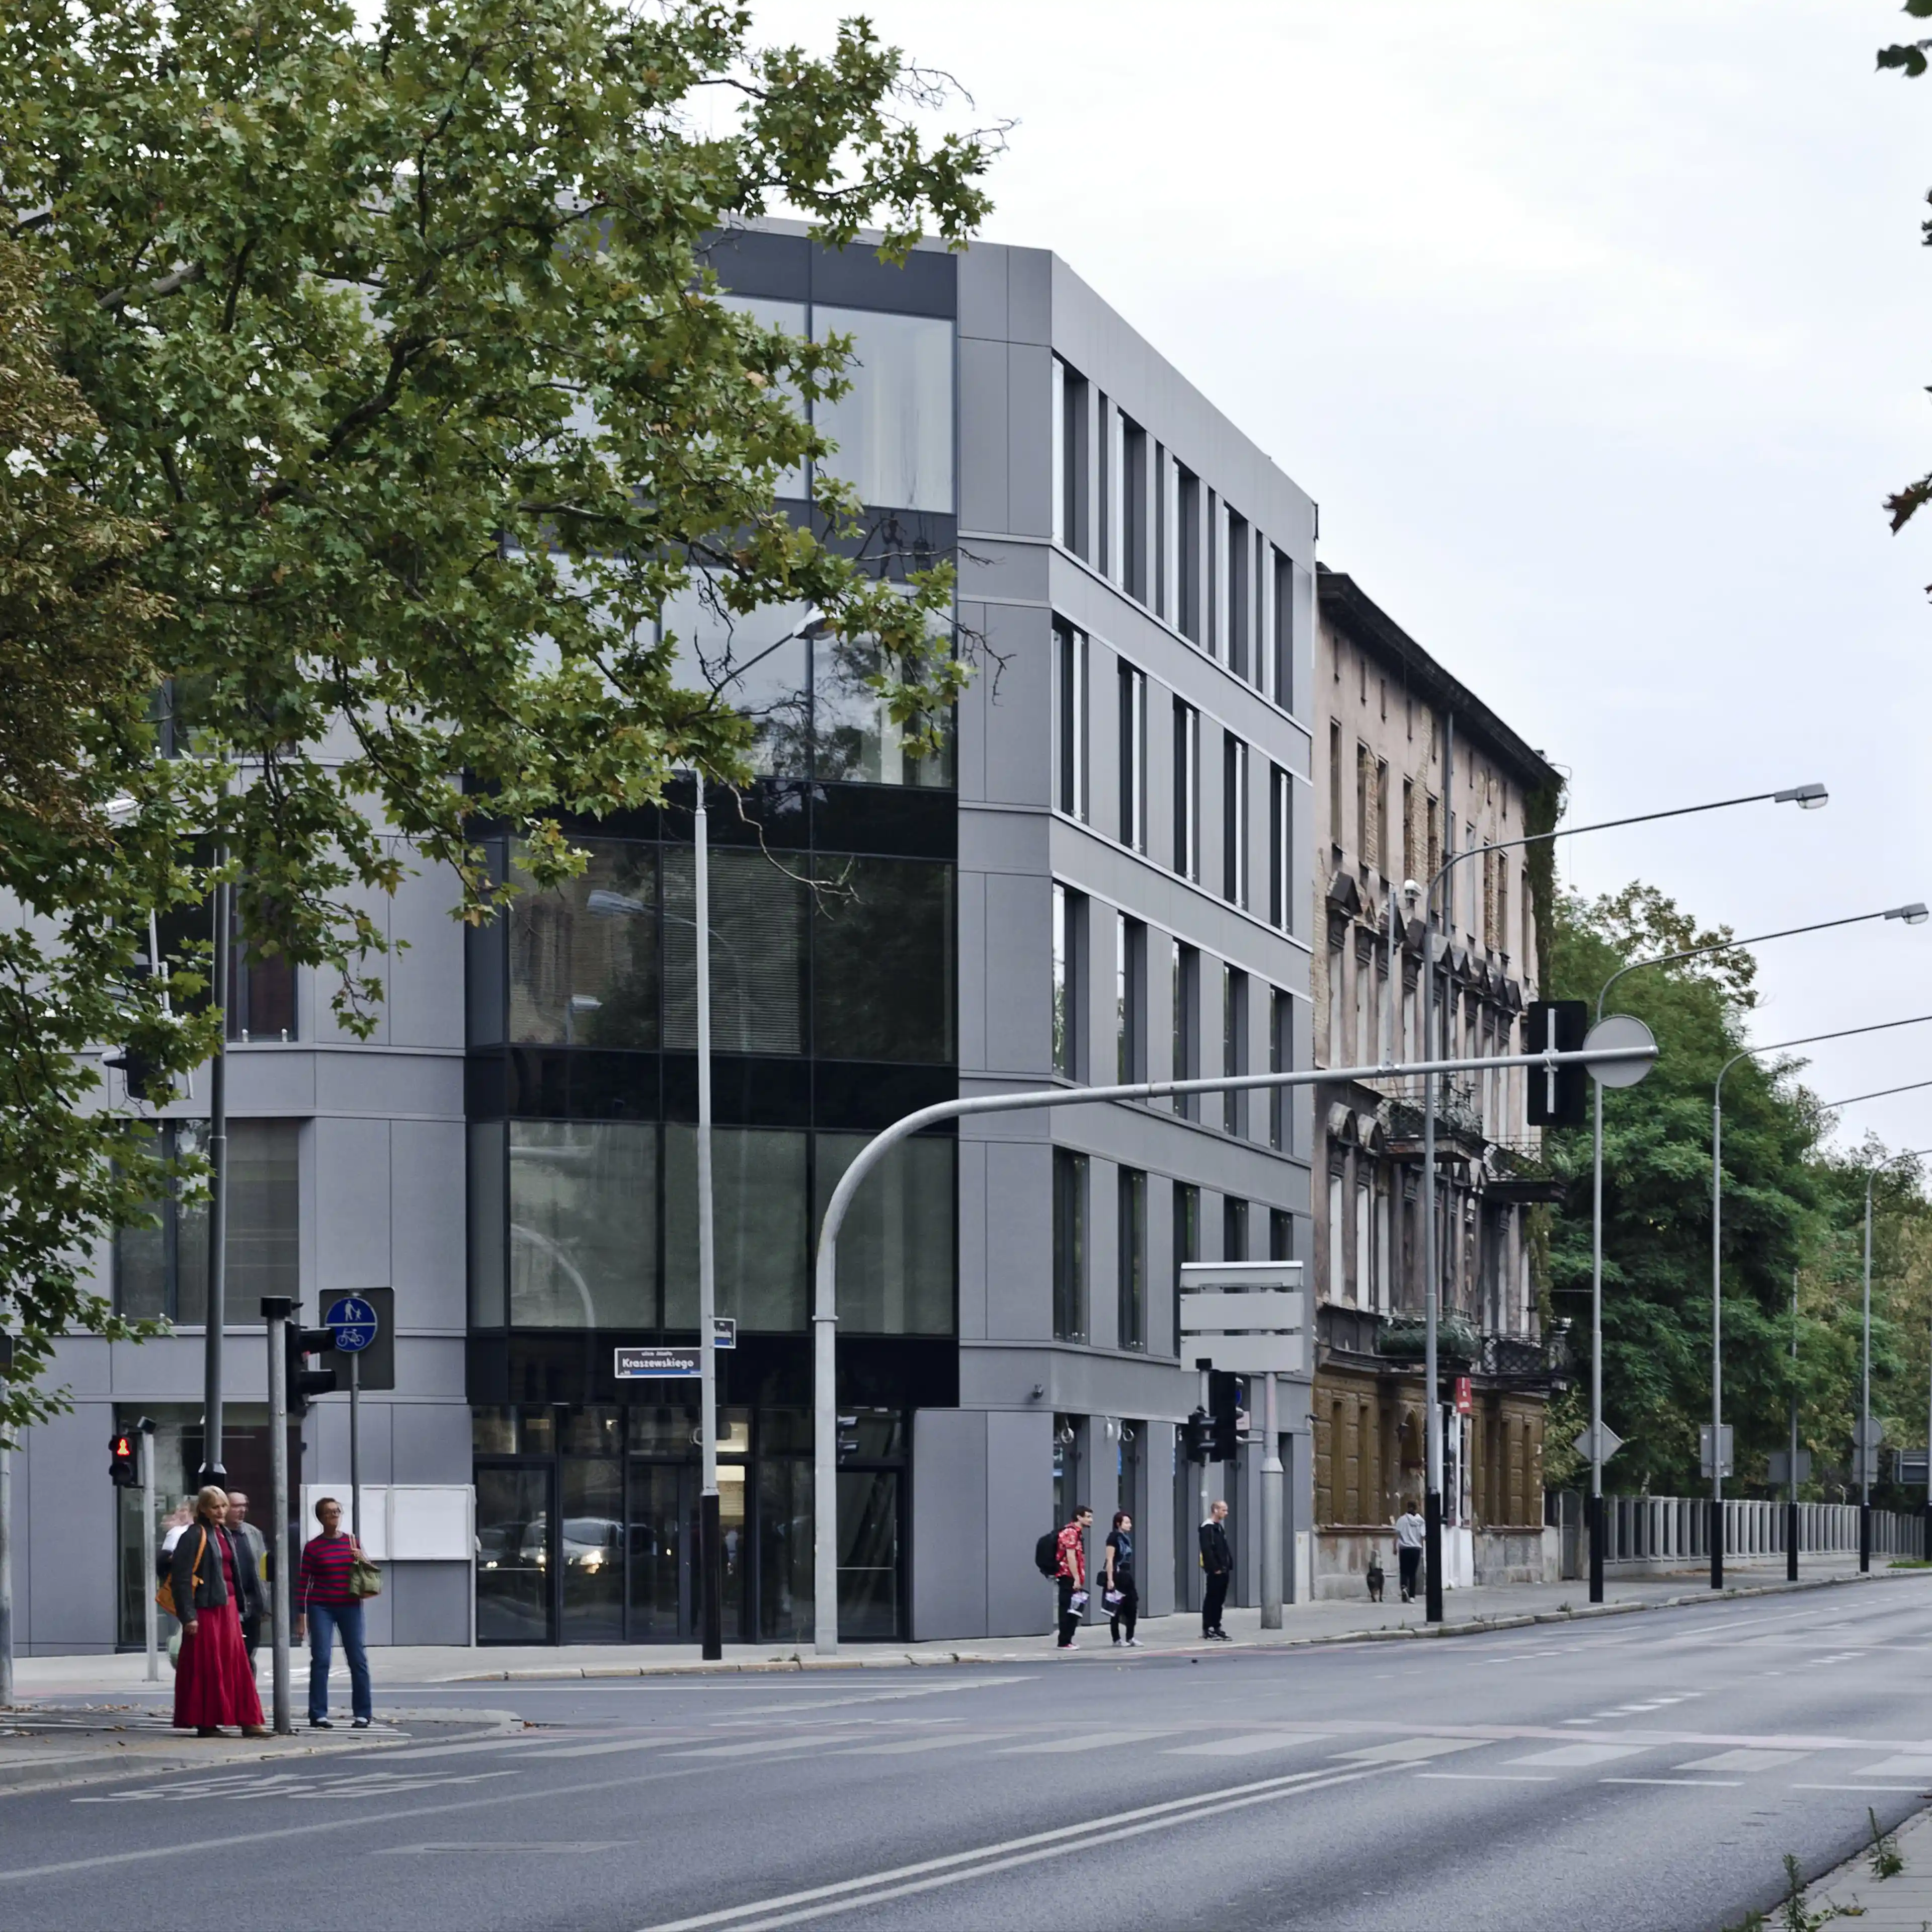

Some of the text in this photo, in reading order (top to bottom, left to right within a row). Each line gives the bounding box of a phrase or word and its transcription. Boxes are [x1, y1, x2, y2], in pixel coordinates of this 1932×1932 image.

[622, 1358, 694, 1369] Kraszewskiego
[151, 1771, 523, 1788] TAXI
[70, 1784, 438, 1802] BUS
